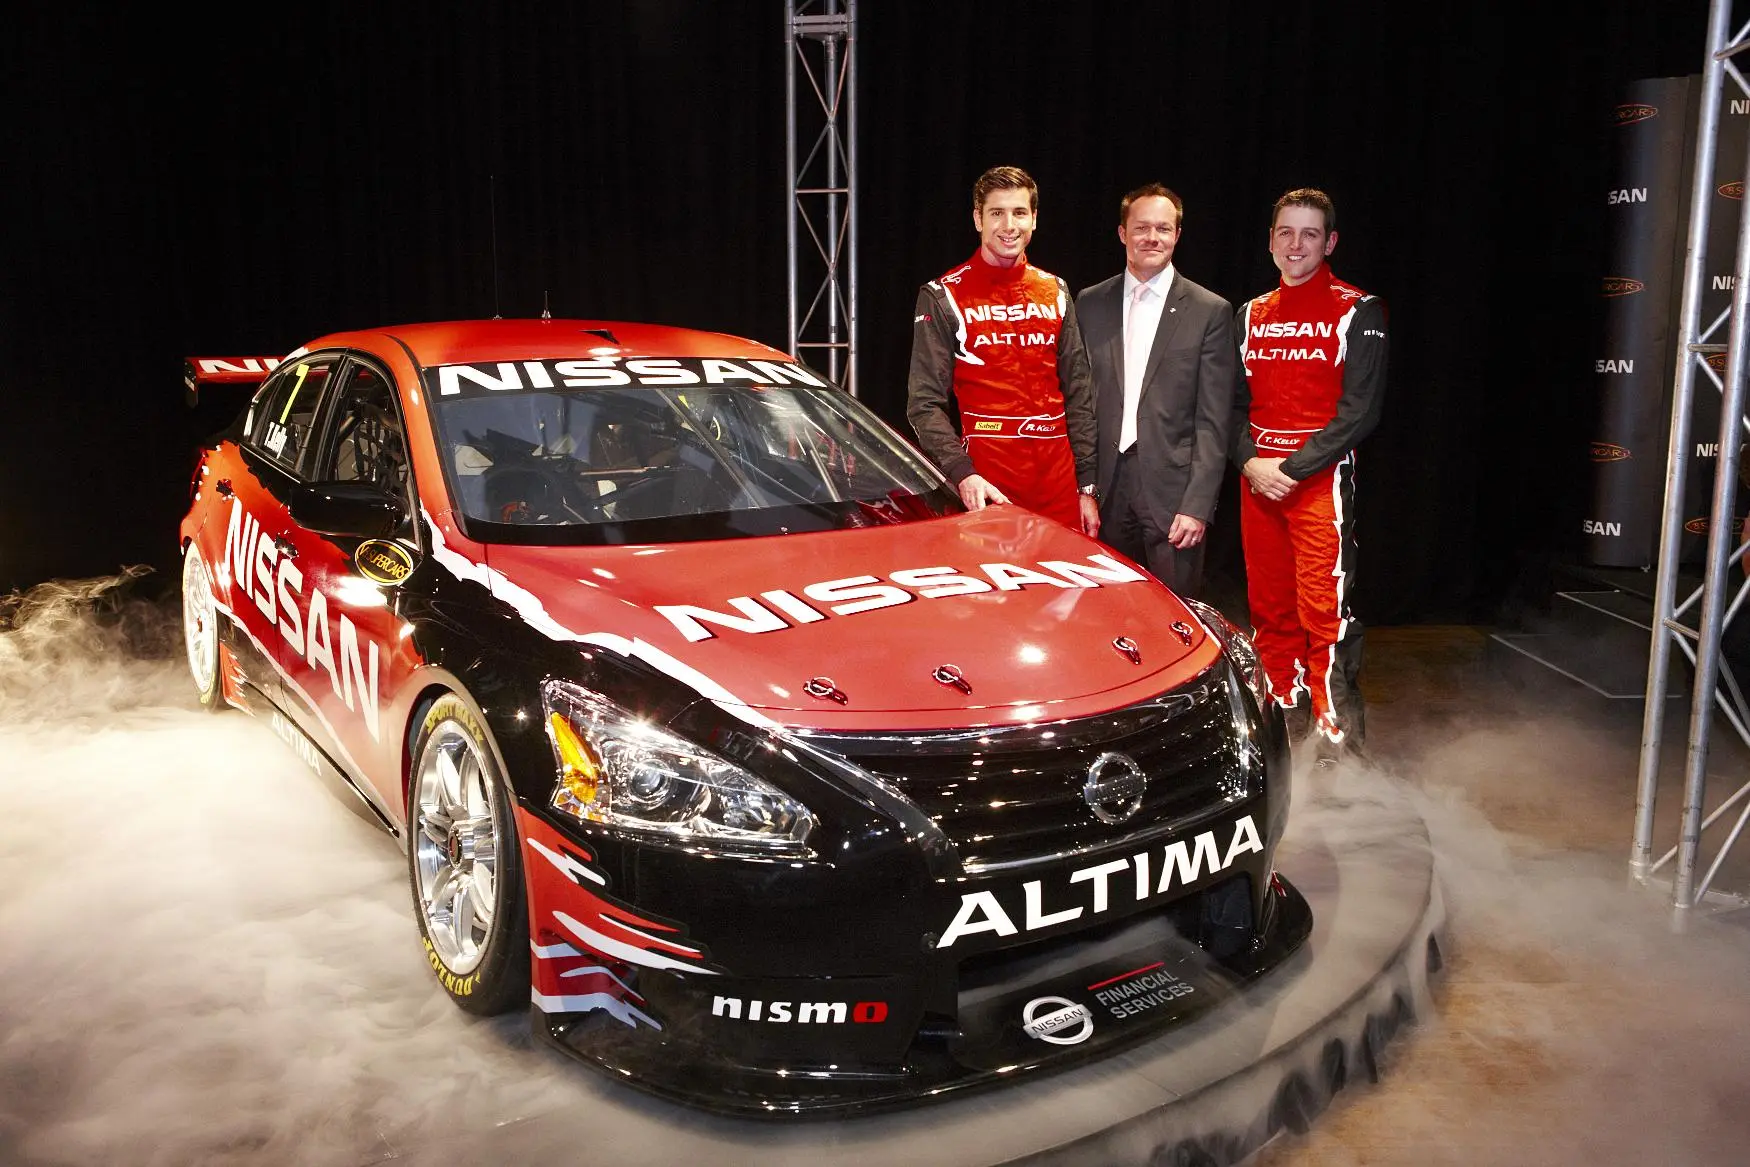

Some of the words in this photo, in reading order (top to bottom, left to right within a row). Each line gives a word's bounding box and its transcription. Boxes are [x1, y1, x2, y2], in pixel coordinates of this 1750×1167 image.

[1608, 188, 1648, 204] SAN
[964, 303, 1058, 323] NISSAN
[973, 332, 1056, 348] ALTIMA
[1249, 321, 1333, 338] NISSAN
[1245, 348, 1328, 361] ALTIMA
[439, 358, 827, 395] NISSAN
[1595, 359, 1634, 374] SAN
[1273, 437, 1300, 445] KELLY
[1583, 519, 1621, 537] SAN
[653, 553, 1150, 642] NISSAN
[224, 496, 380, 744] NISSAN
[936, 814, 1264, 948] ALTIMA
[422, 936, 474, 996] DUNLOP
[1094, 969, 1180, 1007] FINANCIAL
[1109, 981, 1196, 1021] SERVICES
[1031, 1007, 1085, 1034] NISSAN
